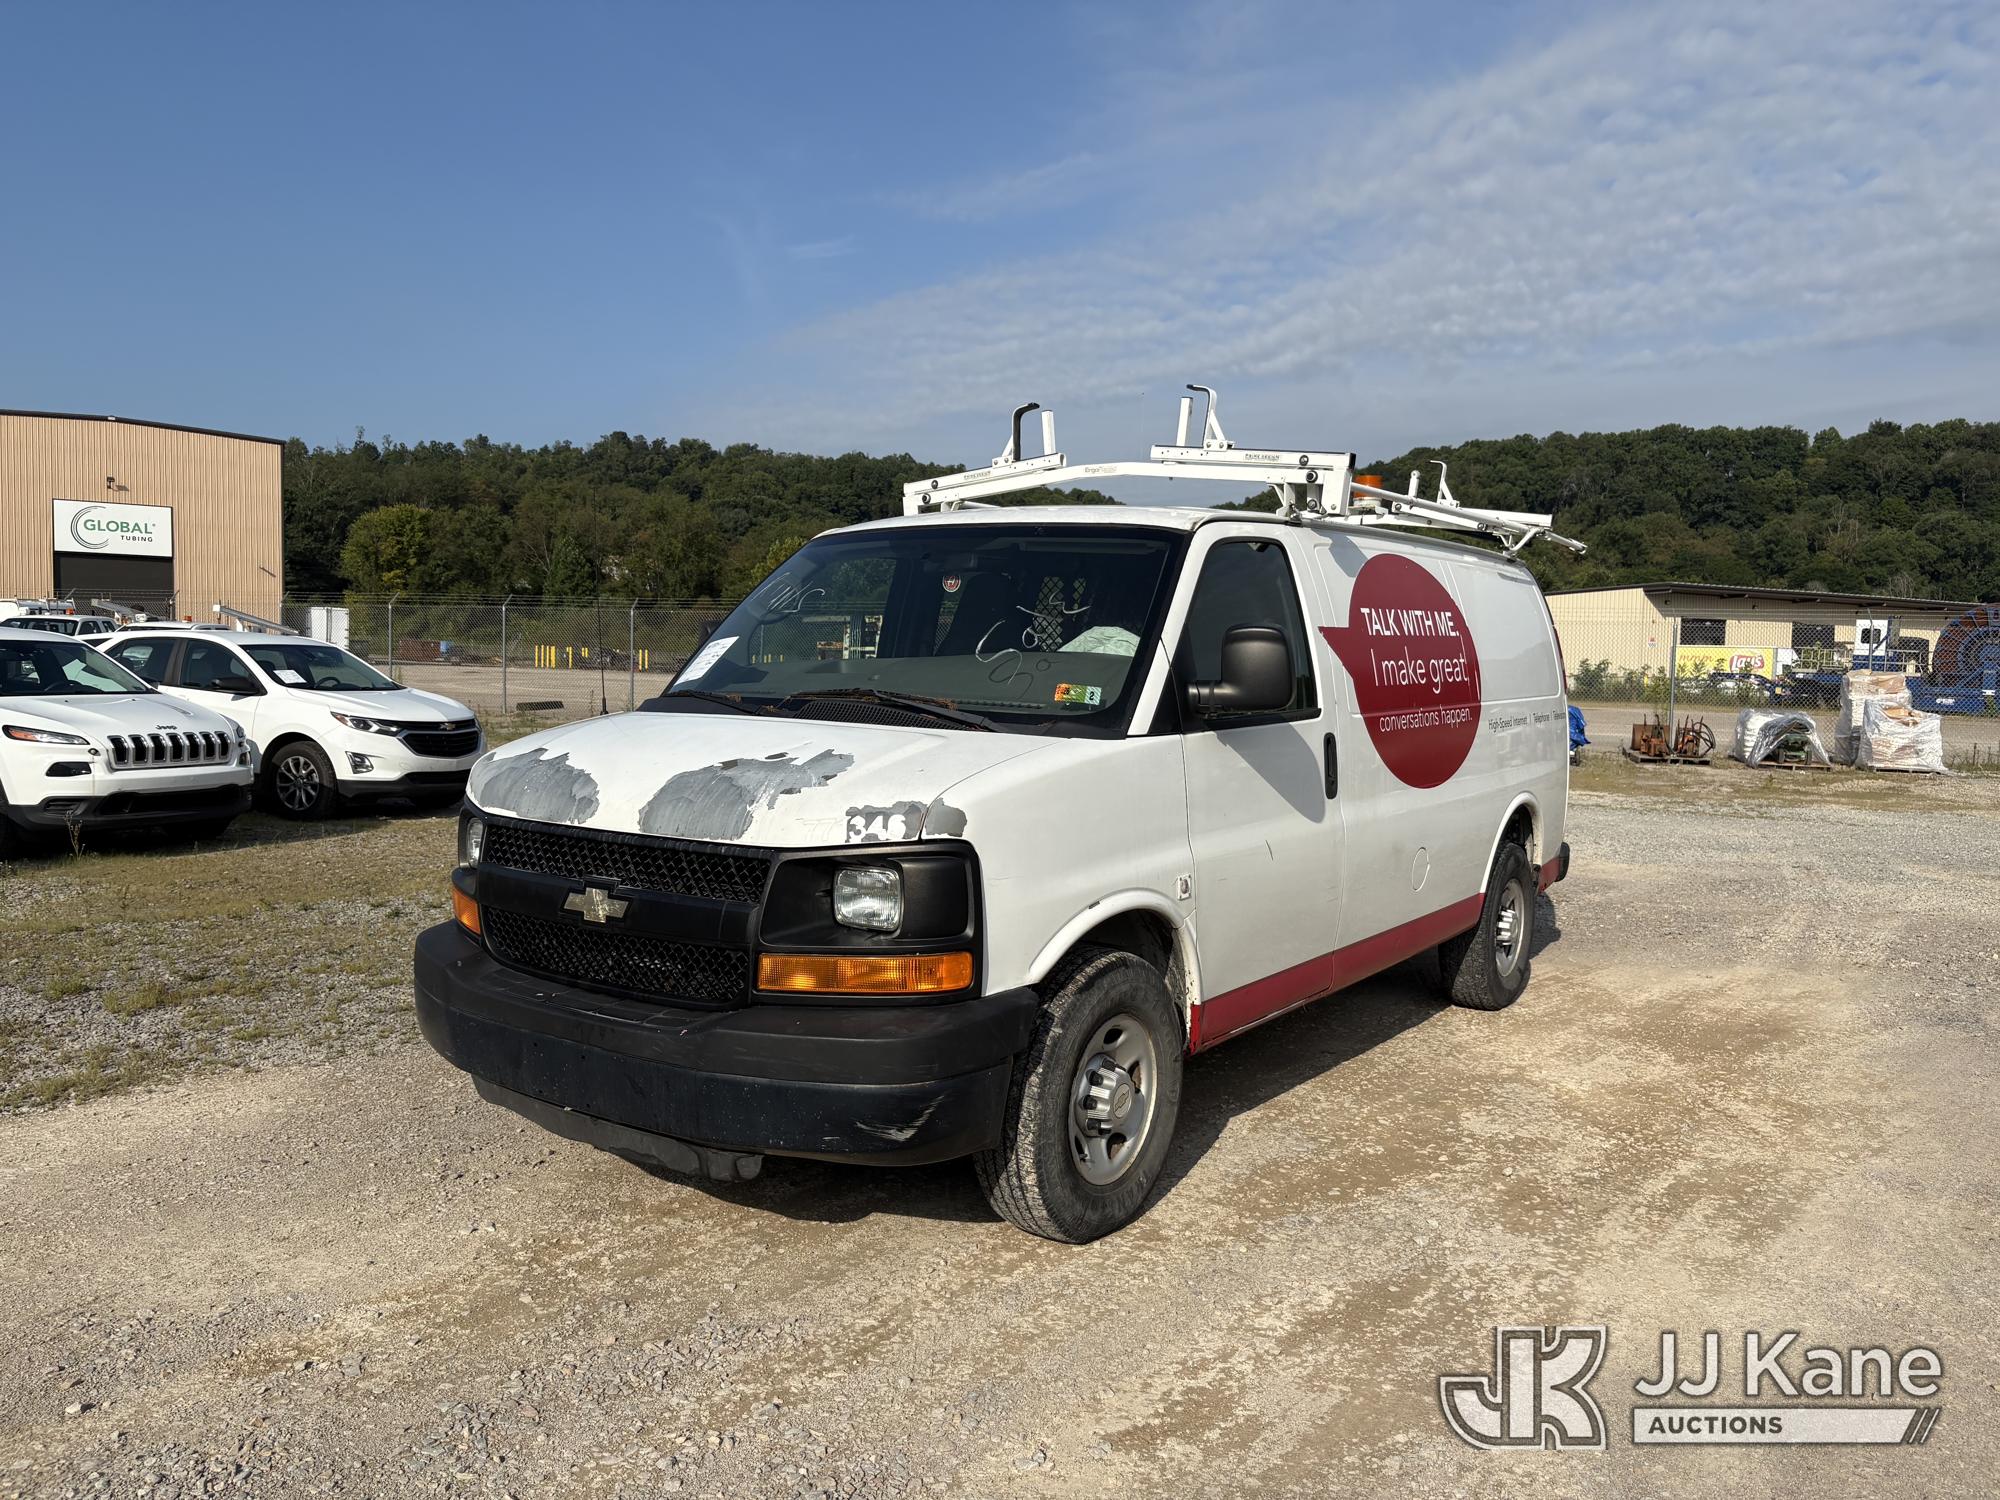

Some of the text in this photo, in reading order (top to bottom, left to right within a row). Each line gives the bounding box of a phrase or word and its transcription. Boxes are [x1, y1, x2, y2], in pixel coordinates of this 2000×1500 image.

[83, 518, 153, 535] GLOBAL
[120, 535, 153, 543] TUBING
[1360, 607, 1460, 637] TALK WITH ME.
[1370, 645, 1469, 694] I make great
[1088, 691, 1095, 701] 2
[1379, 703, 1473, 733] conversations happen.
[1488, 715, 1513, 733] High-Speed
[848, 814, 906, 842] 346
